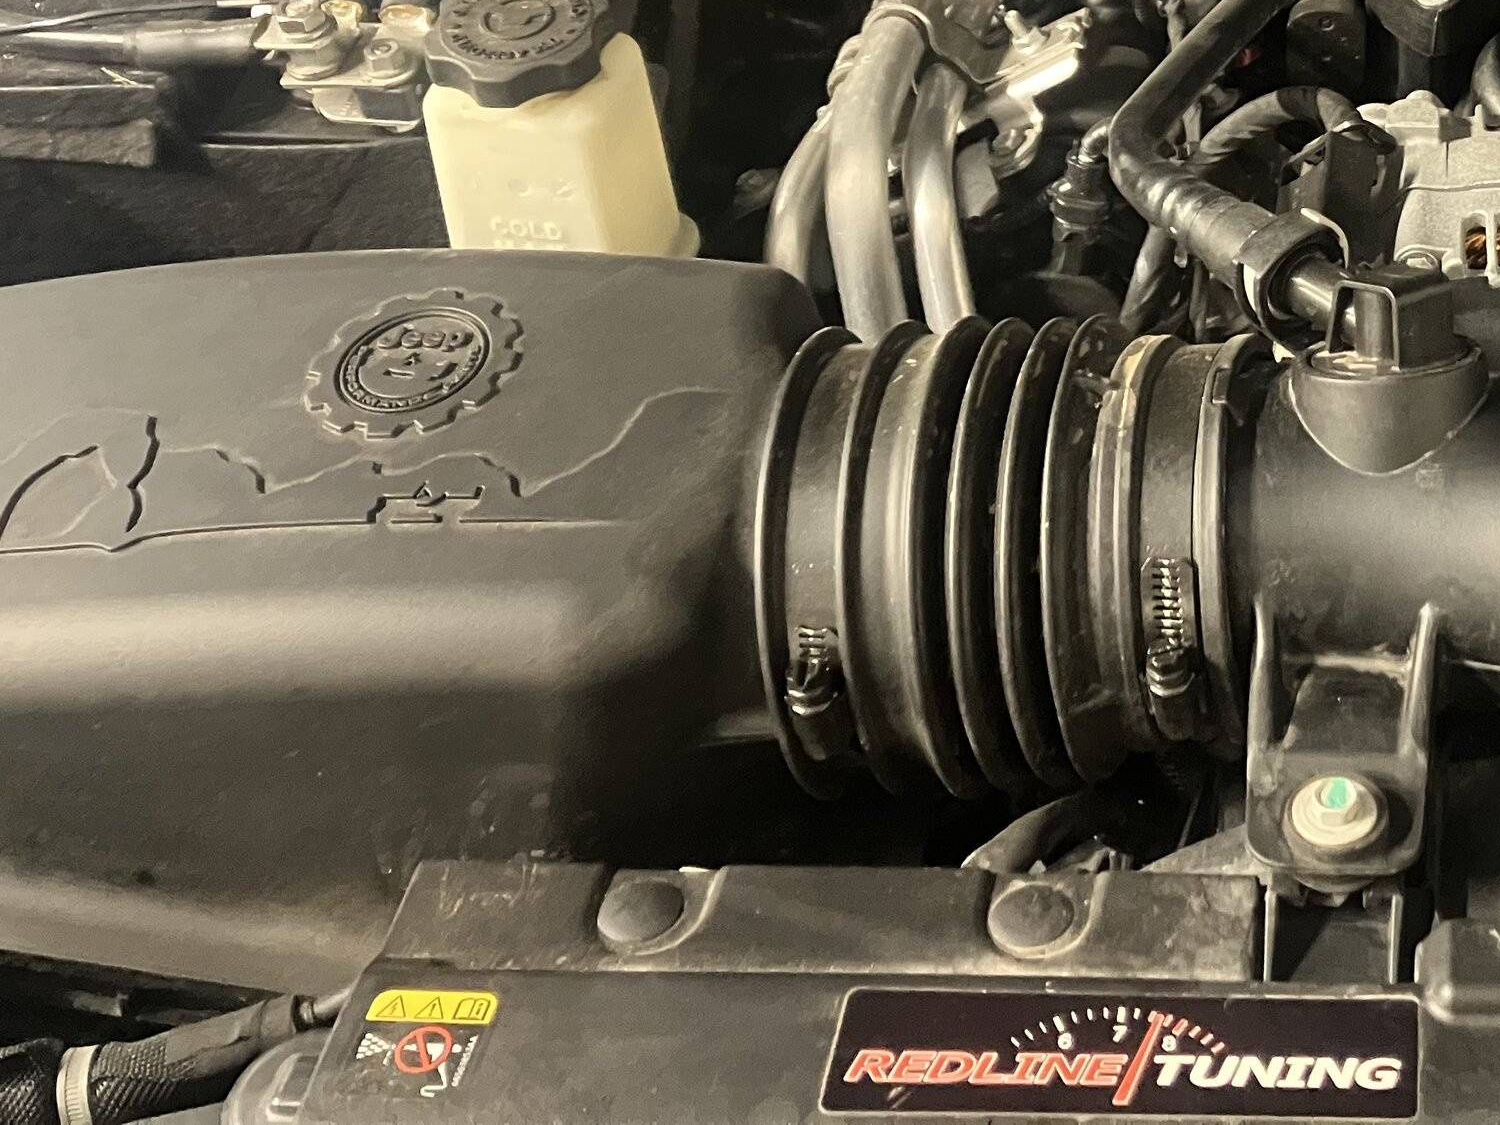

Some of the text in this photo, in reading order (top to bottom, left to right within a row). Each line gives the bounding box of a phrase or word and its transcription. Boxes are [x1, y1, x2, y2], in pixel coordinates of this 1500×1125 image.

[489, 216, 562, 240] COLD
[376, 324, 475, 353] Jeep
[1056, 1025, 1177, 1052] 6 7 8
[842, 1048, 1402, 1091] REDLINE TUNING
